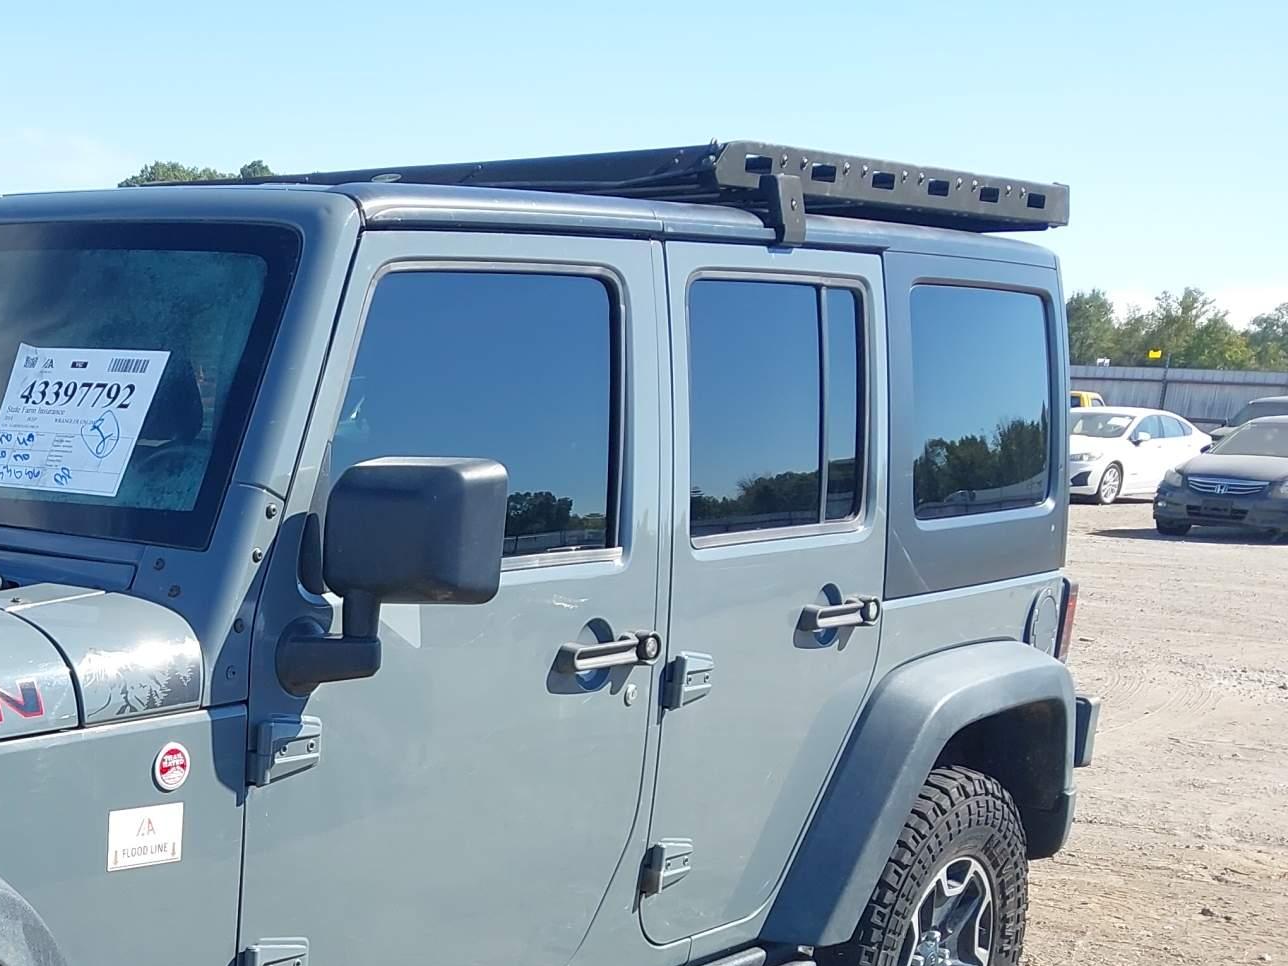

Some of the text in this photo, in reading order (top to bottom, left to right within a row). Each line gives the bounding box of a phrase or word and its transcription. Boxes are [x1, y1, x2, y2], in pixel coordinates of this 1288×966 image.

[19, 380, 136, 409] 43397792
[21, 406, 37, 414] Farm
[38, 407, 65, 415] Insurance
[122, 842, 169, 859] FLOOD LINE
